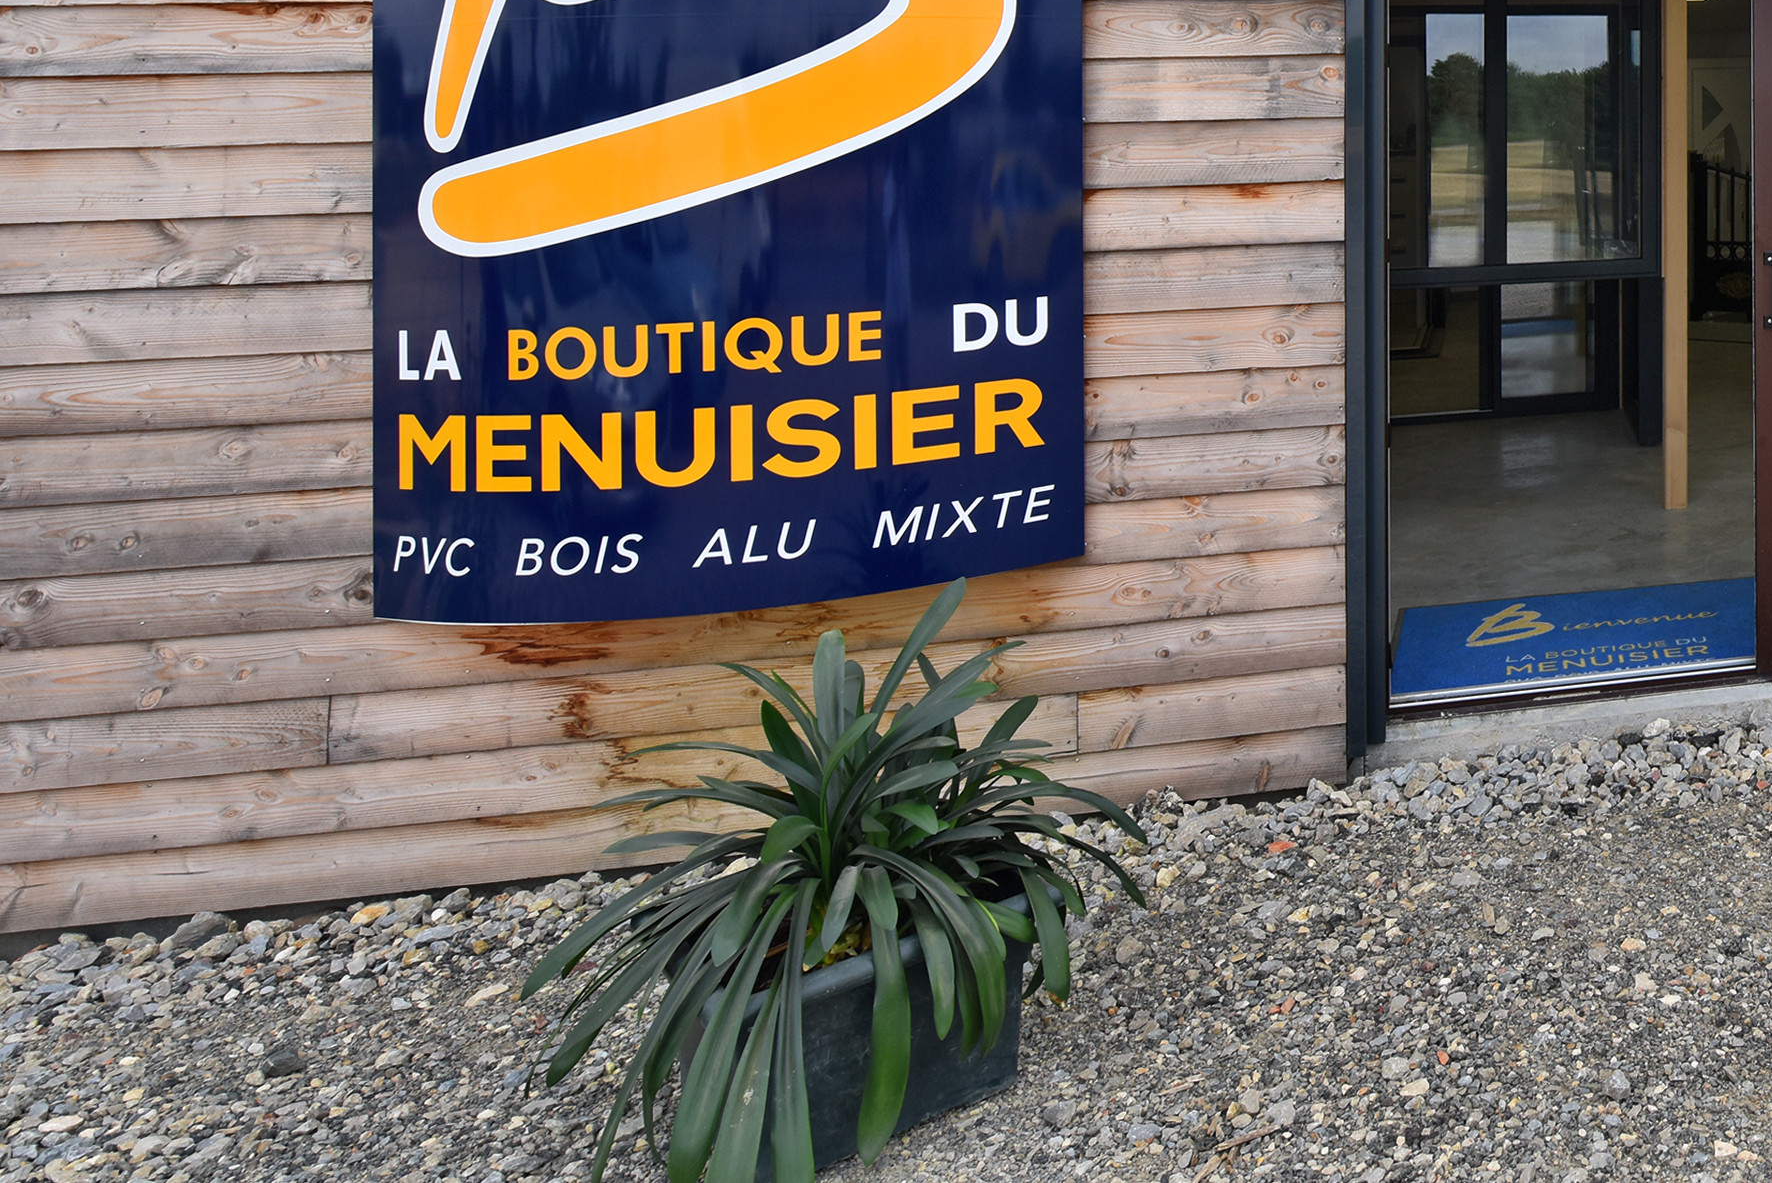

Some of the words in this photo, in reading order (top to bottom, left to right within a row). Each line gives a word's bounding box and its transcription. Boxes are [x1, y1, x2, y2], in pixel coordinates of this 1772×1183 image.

[398, 329, 462, 381] LA
[508, 310, 882, 381] BOUTIQUE
[953, 296, 1049, 354] DU
[398, 378, 1046, 492] MENUISIER
[393, 535, 475, 577] PVC
[515, 532, 644, 576] BOIS
[692, 519, 817, 568] ALU
[872, 484, 1055, 550] MIXTE
[1465, 603, 1719, 647] Bienvenue
[1505, 654, 1536, 663] LA
[1545, 639, 1668, 659] BOUTIQUE
[1675, 636, 1708, 646] DU
[1506, 645, 1710, 676] MENUISIER
